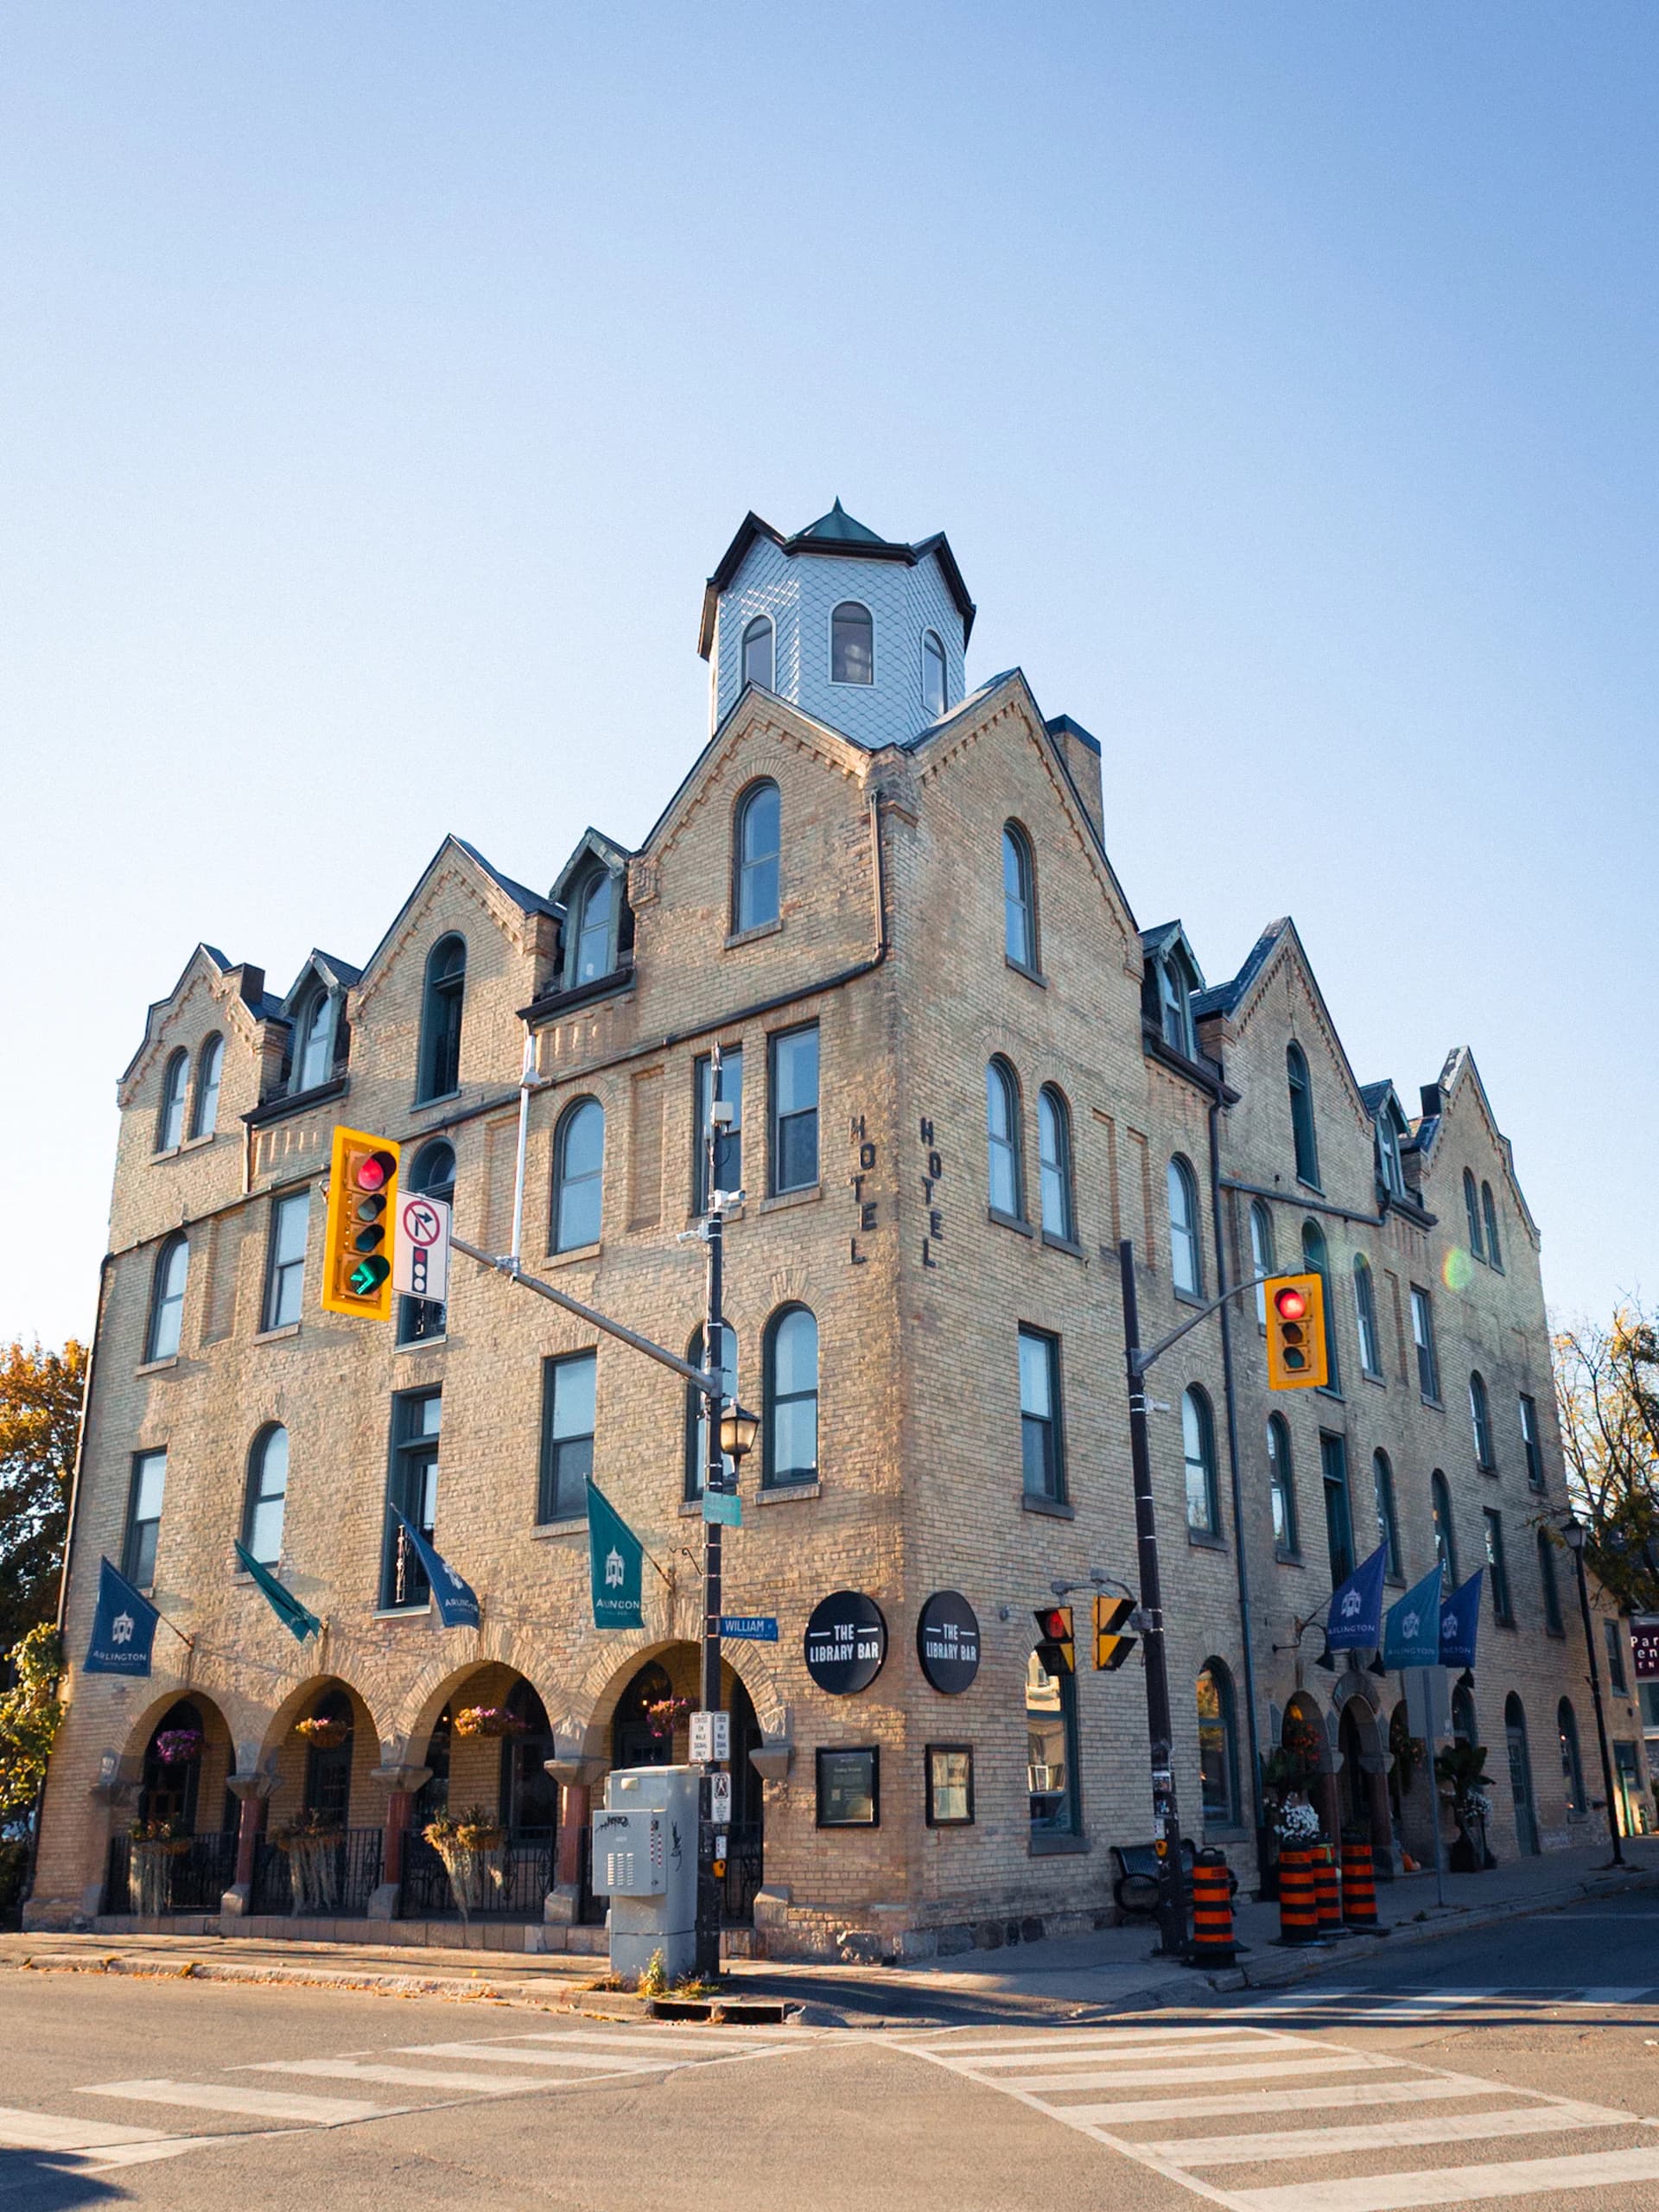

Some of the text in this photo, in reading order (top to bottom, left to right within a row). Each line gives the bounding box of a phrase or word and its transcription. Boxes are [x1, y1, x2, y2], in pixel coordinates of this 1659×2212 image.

[849, 1115, 877, 1264] HOTEL
[920, 1117, 943, 1268] HOTEL
[596, 1599, 639, 1609] ALINGON
[725, 1619, 764, 1632] WILLIAM
[834, 1624, 855, 1641] THE
[943, 1624, 958, 1641] THE
[810, 1642, 879, 1662] LIBRARY BAR
[926, 1642, 976, 1662] LIBRARY BAR
